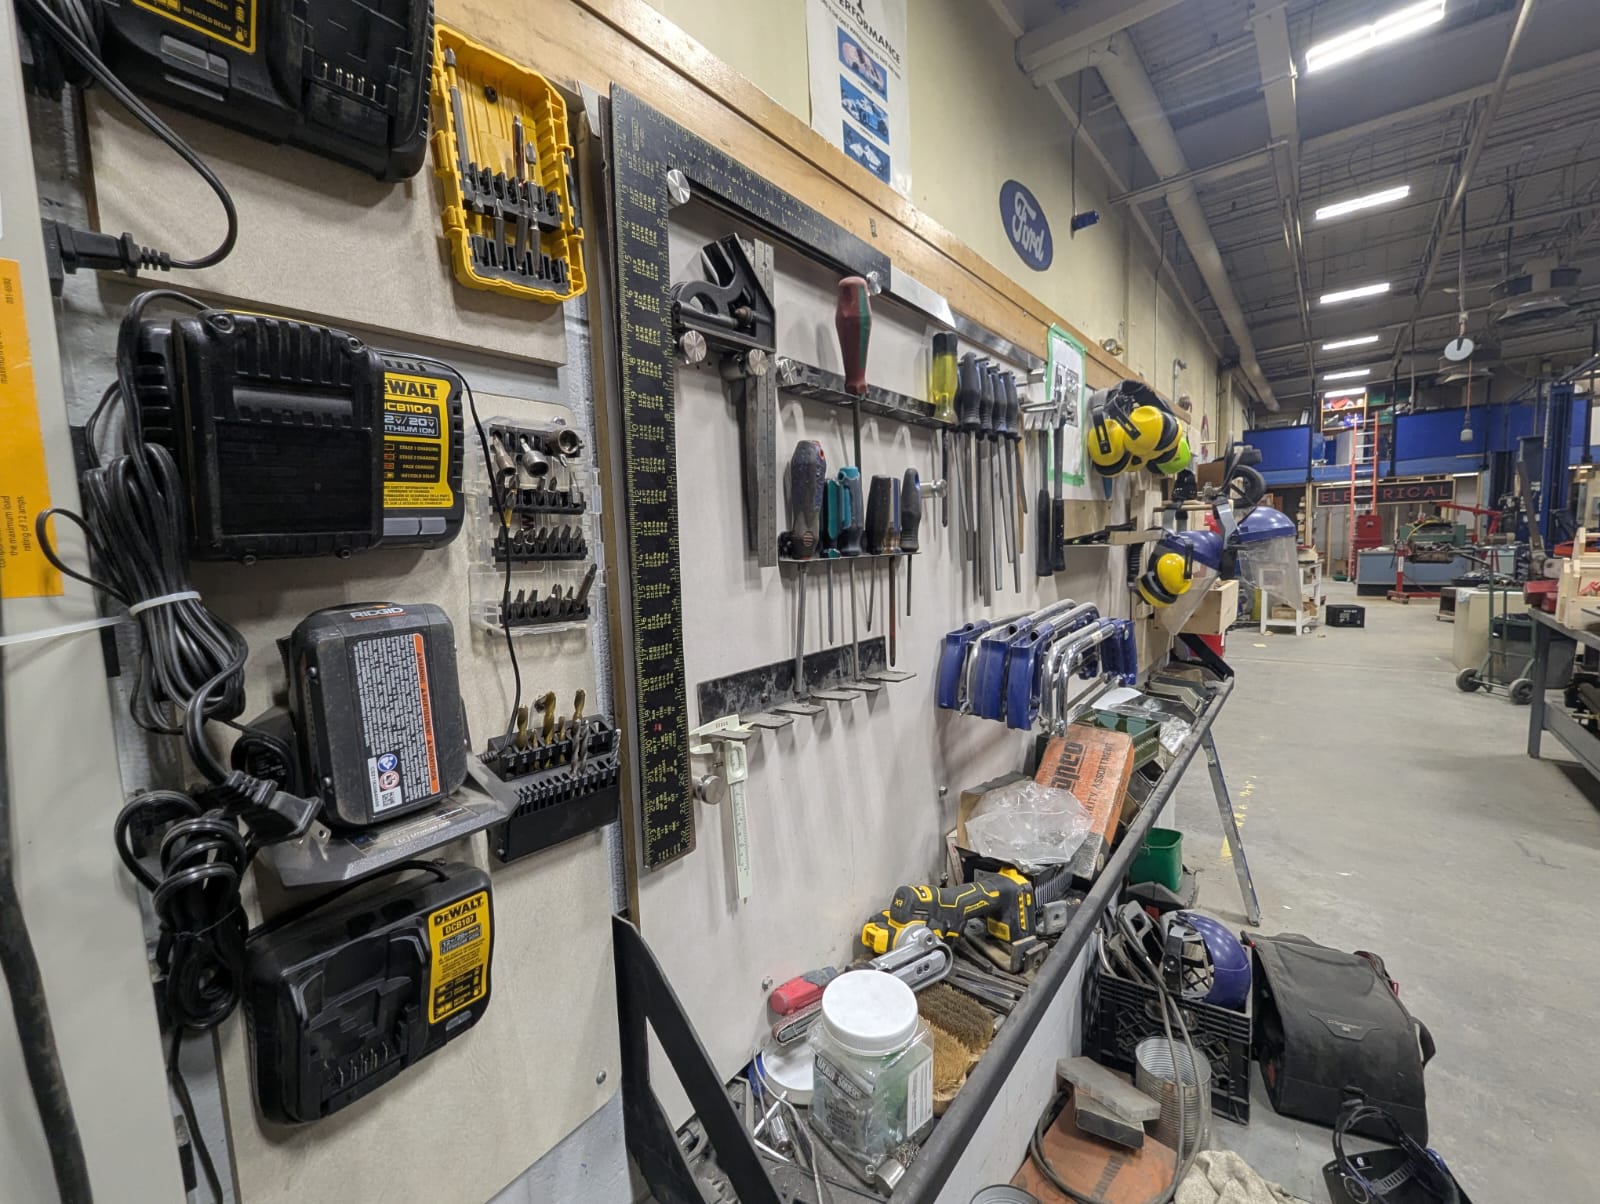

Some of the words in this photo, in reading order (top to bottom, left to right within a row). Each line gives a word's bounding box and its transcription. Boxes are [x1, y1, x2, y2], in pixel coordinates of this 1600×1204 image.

[839, 0, 901, 64] ERFORMANCE
[1012, 191, 1044, 262] Ford
[384, 378, 438, 398] EWALT
[384, 415, 435, 427] 2V/20V
[384, 425, 417, 433] ITHIUM
[419, 427, 436, 435] ION
[0, 495, 11, 510] load
[1320, 485, 1449, 503] ELERICAL
[16, 496, 27, 514] amps
[5, 512, 16, 544] maximum
[17, 515, 26, 523] 12
[8, 545, 17, 556] the
[20, 533, 32, 551] rating
[350, 607, 404, 618] RIDGID
[1085, 791, 1098, 814] ILITY
[1092, 742, 1114, 790] ASSORTMENT
[434, 896, 482, 926] DEWALT
[445, 915, 474, 934] DCB107
